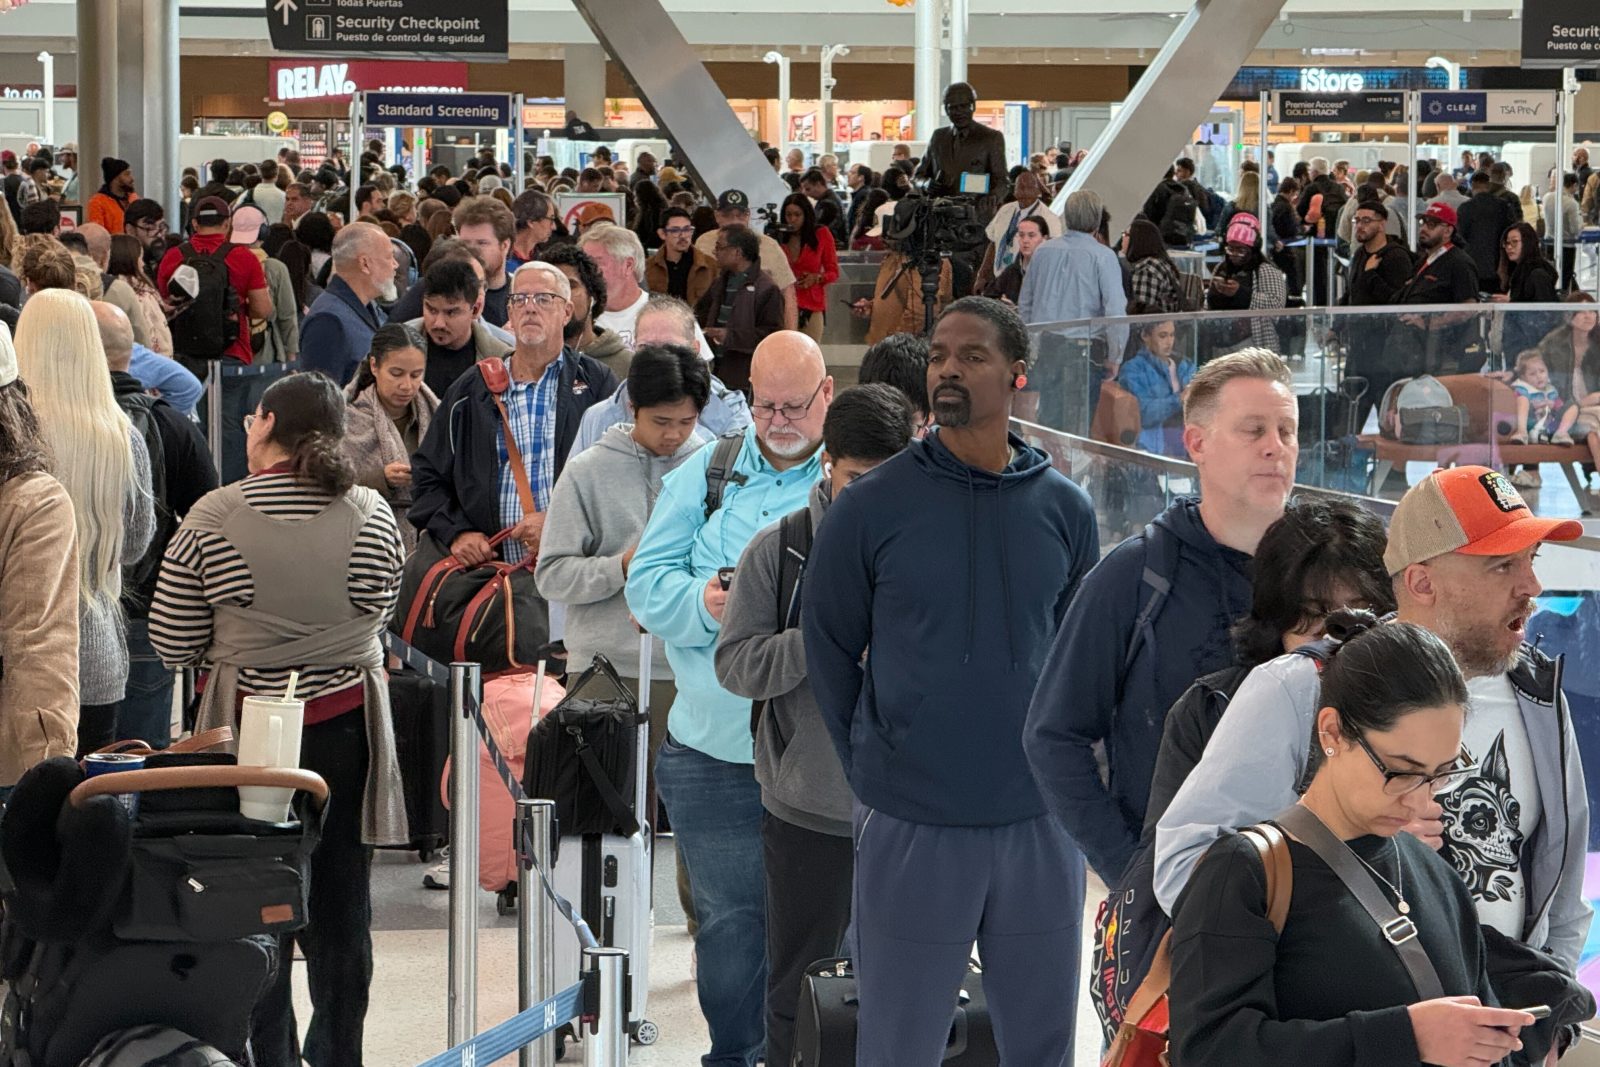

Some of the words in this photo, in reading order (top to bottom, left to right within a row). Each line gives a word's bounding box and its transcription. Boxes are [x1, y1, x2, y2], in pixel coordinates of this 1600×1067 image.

[366, 0, 404, 8] Puertas
[336, 15, 395, 31] Security
[399, 16, 480, 32] Checkpoint
[1552, 25, 1600, 39] Securit
[336, 32, 369, 42] Puesto
[372, 33, 384, 42] de
[387, 33, 421, 43] control
[423, 34, 435, 43] de
[437, 34, 485, 45] seguridad
[1547, 41, 1579, 50] Puesto
[1580, 41, 1592, 50] de
[1300, 67, 1364, 92] iStore
[1285, 101, 1315, 109] Premier
[1446, 104, 1477, 112] CLEAR
[1500, 105, 1515, 115] TSA
[377, 104, 434, 117] Standard
[438, 104, 499, 120] Screening
